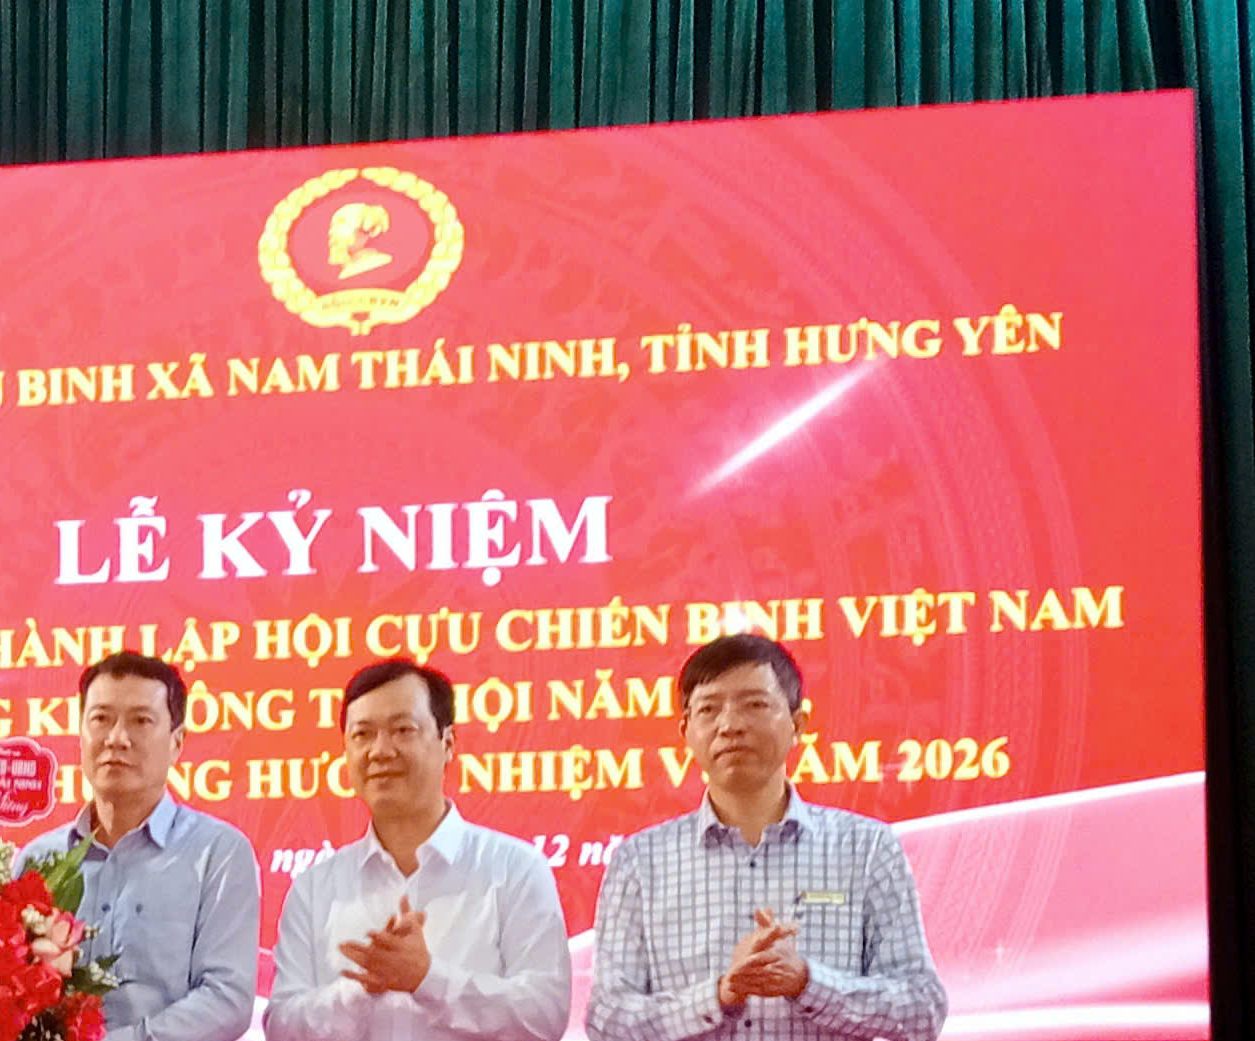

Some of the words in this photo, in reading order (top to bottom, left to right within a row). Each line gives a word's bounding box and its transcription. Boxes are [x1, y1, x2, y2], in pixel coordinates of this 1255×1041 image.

[17, 364, 135, 406] BINH
[146, 352, 214, 400] XÃ
[226, 353, 341, 396] NAM
[351, 338, 474, 389] THÁI
[487, 337, 630, 383] NINH,
[641, 323, 770, 373] TỈNH
[783, 317, 943, 367] HƯNG
[953, 303, 1063, 356] YÊN
[53, 496, 170, 585] LỄ
[196, 488, 333, 579] KỶ
[356, 488, 613, 586] NIỆM
[253, 613, 352, 668] HỘI
[365, 606, 482, 665] CỰU
[495, 596, 670, 651] CHIẾN
[685, 598, 824, 645] BINH
[838, 588, 976, 646] VIỆT
[989, 586, 1125, 633] NAM
[185, 679, 296, 733] ÔNG
[547, 668, 675, 721] NĂM
[459, 744, 644, 800] NHIỆM
[790, 732, 883, 783] ĂM
[897, 736, 1010, 782] 2026
